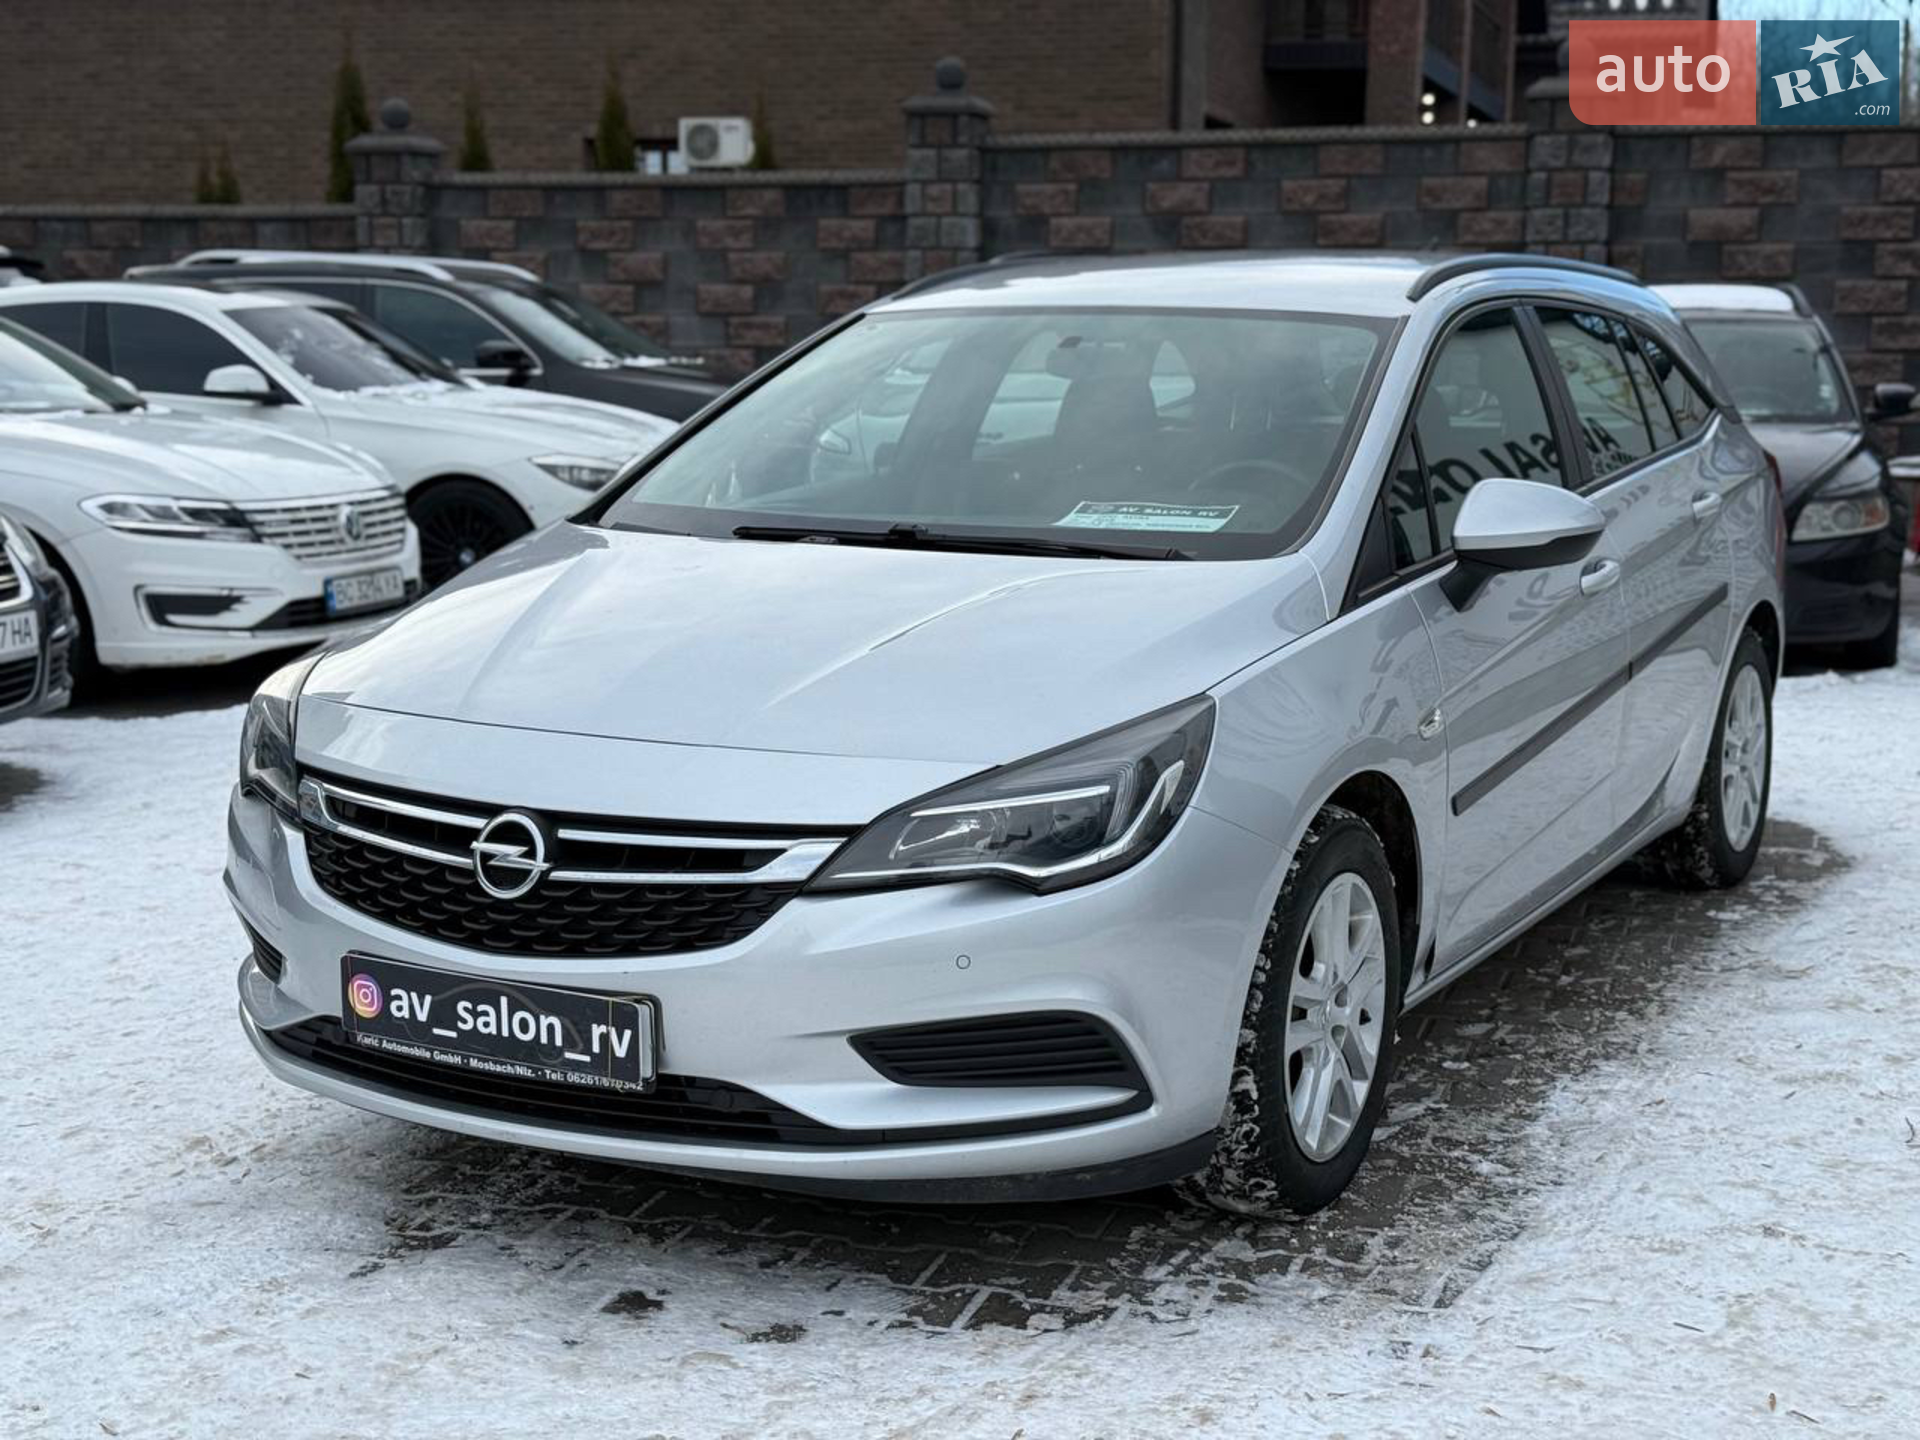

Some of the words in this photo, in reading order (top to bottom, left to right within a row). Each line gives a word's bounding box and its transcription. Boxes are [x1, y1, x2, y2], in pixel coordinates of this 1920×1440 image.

[11, 616, 34, 647] HA
[390, 988, 632, 1063] av_salon_rv
[382, 1039, 431, 1058] Automobile
[433, 1050, 461, 1064] GmbH
